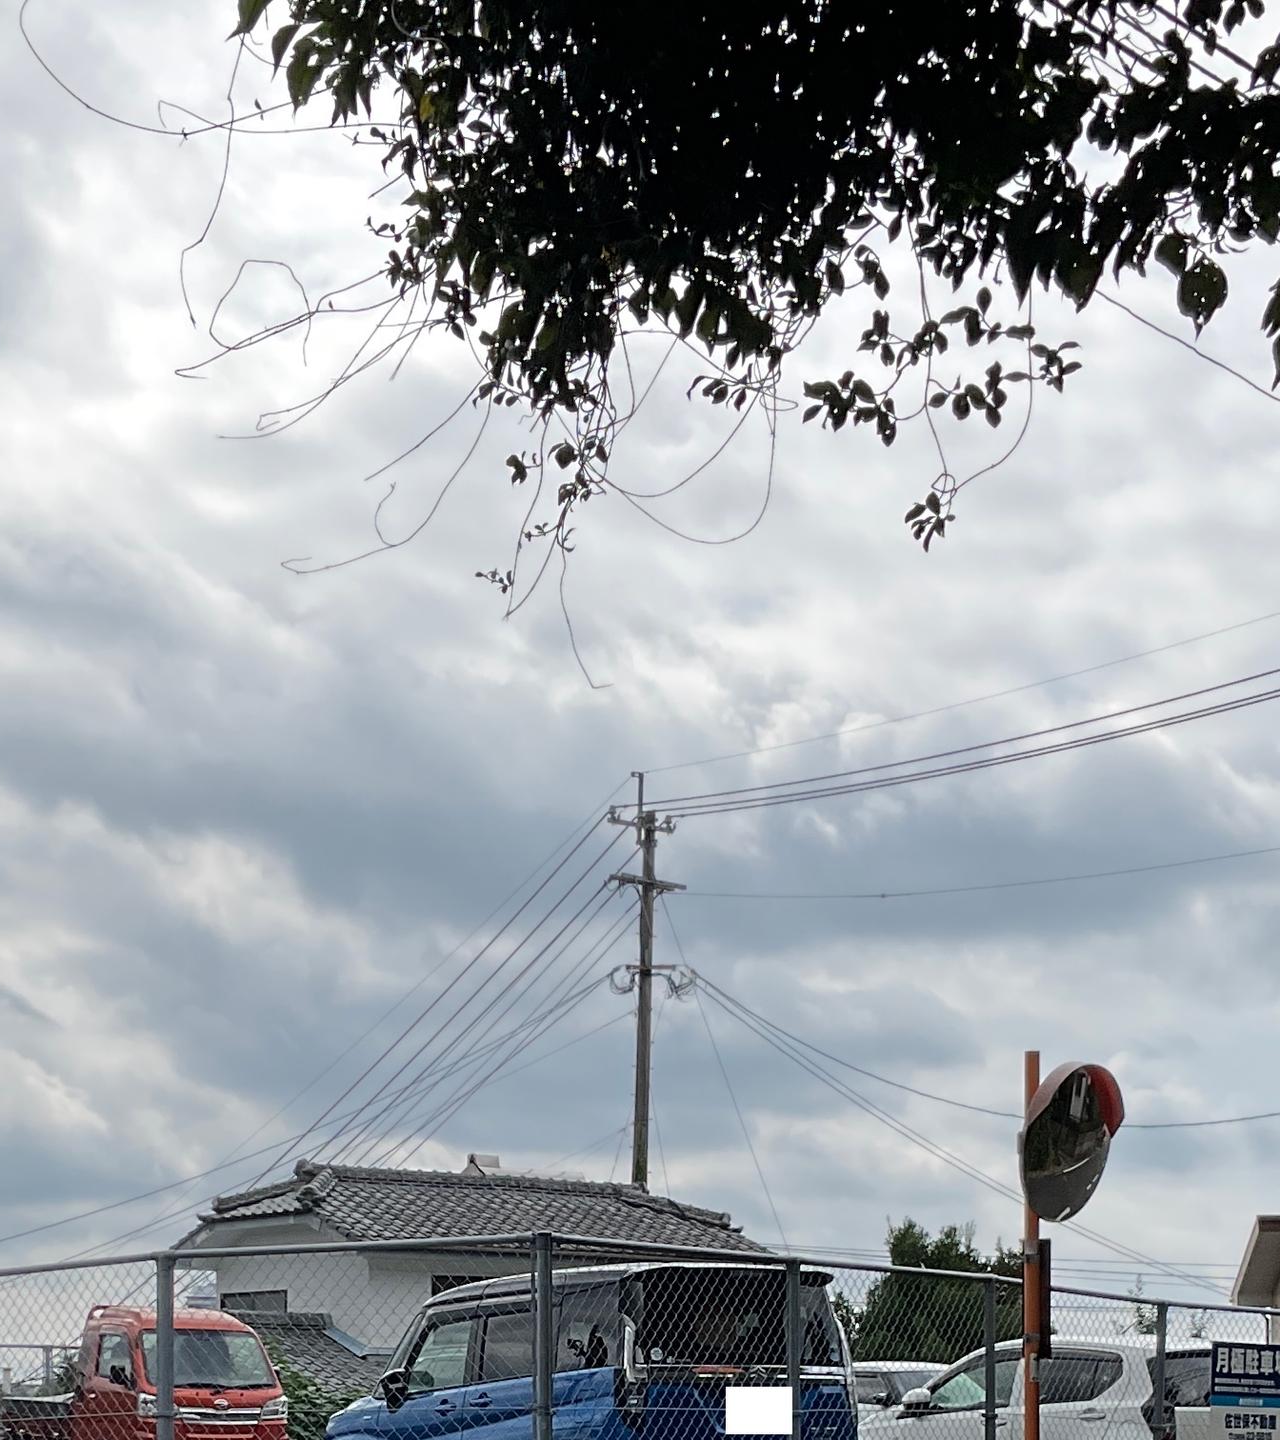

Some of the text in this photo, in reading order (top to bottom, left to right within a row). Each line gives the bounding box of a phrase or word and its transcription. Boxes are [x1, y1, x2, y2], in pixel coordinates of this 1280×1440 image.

[1224, 1413, 1277, 1429] 佐世保不動産
